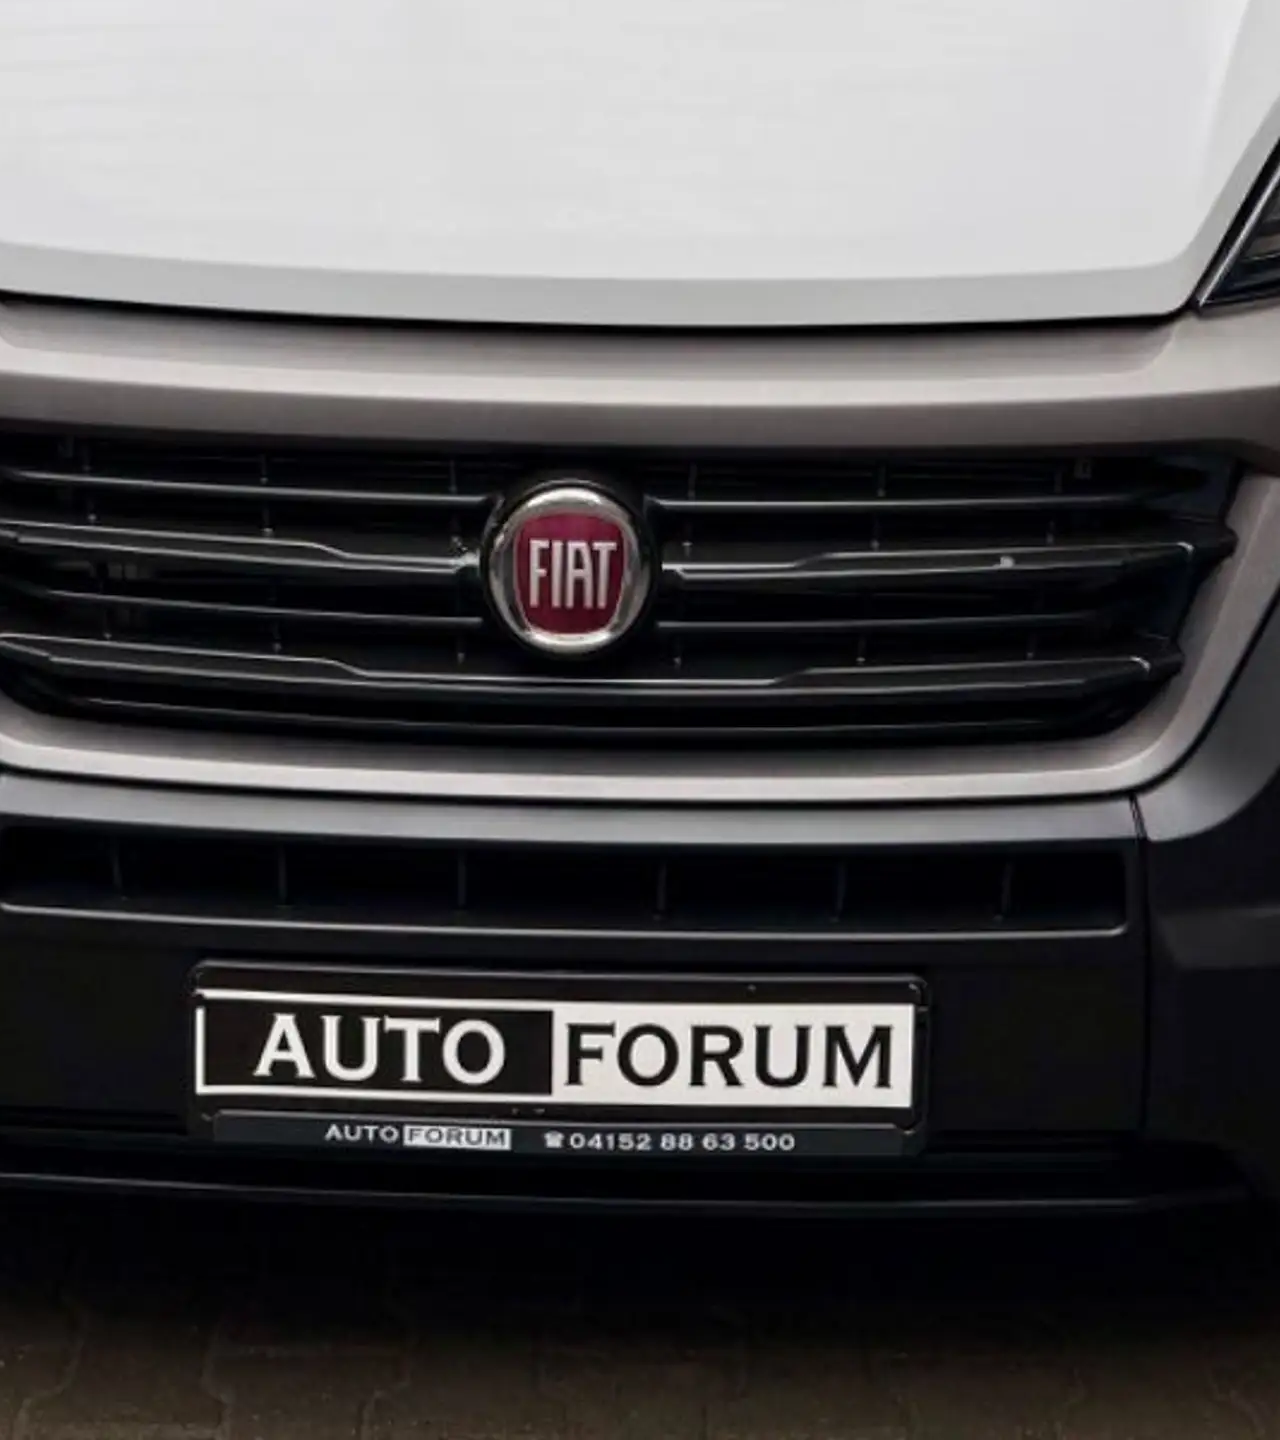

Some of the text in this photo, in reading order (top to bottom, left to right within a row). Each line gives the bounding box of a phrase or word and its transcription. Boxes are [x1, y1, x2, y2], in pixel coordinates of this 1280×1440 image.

[529, 538, 618, 609] FIAT
[252, 1012, 893, 1089] AUTO FORUM
[324, 1123, 796, 1152] AUTO FORUM 04152 88 63 500
